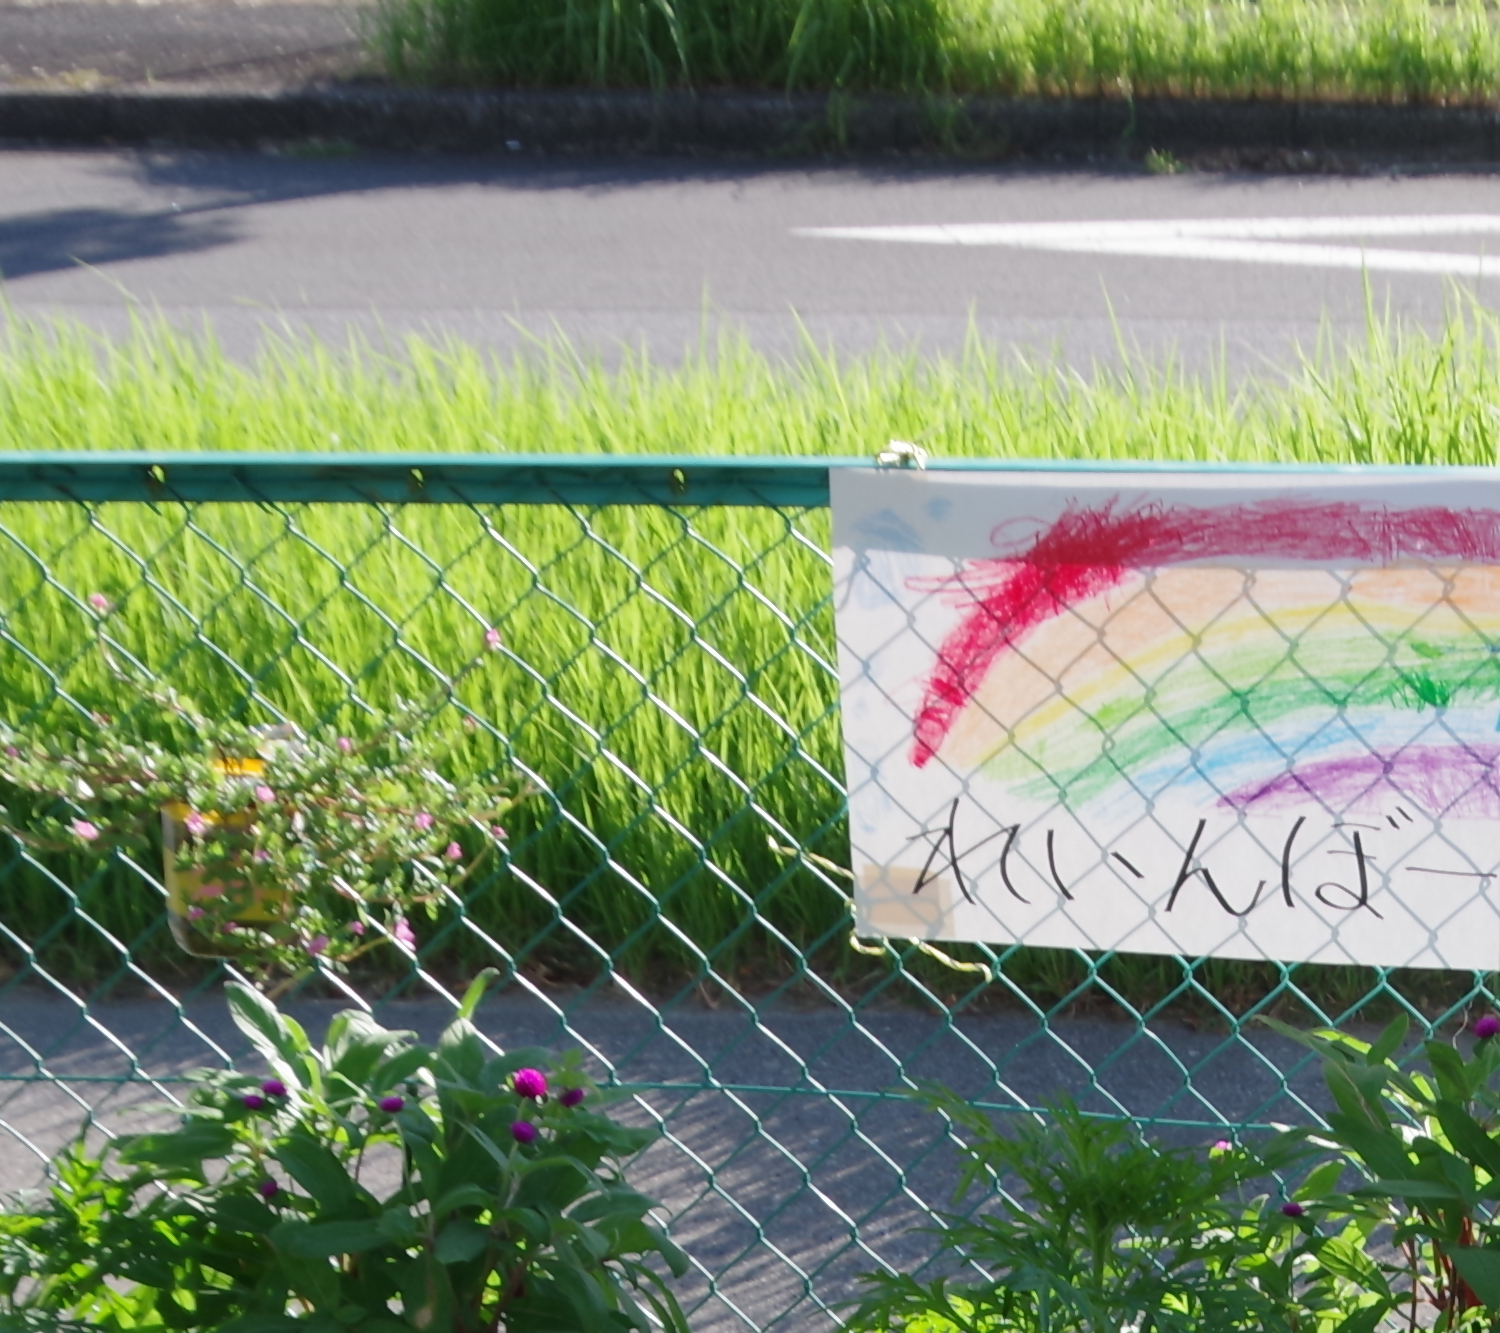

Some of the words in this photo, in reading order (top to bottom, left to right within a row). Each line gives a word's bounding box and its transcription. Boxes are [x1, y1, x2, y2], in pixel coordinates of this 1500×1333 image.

[905, 797, 1498, 921] れいんぼー
